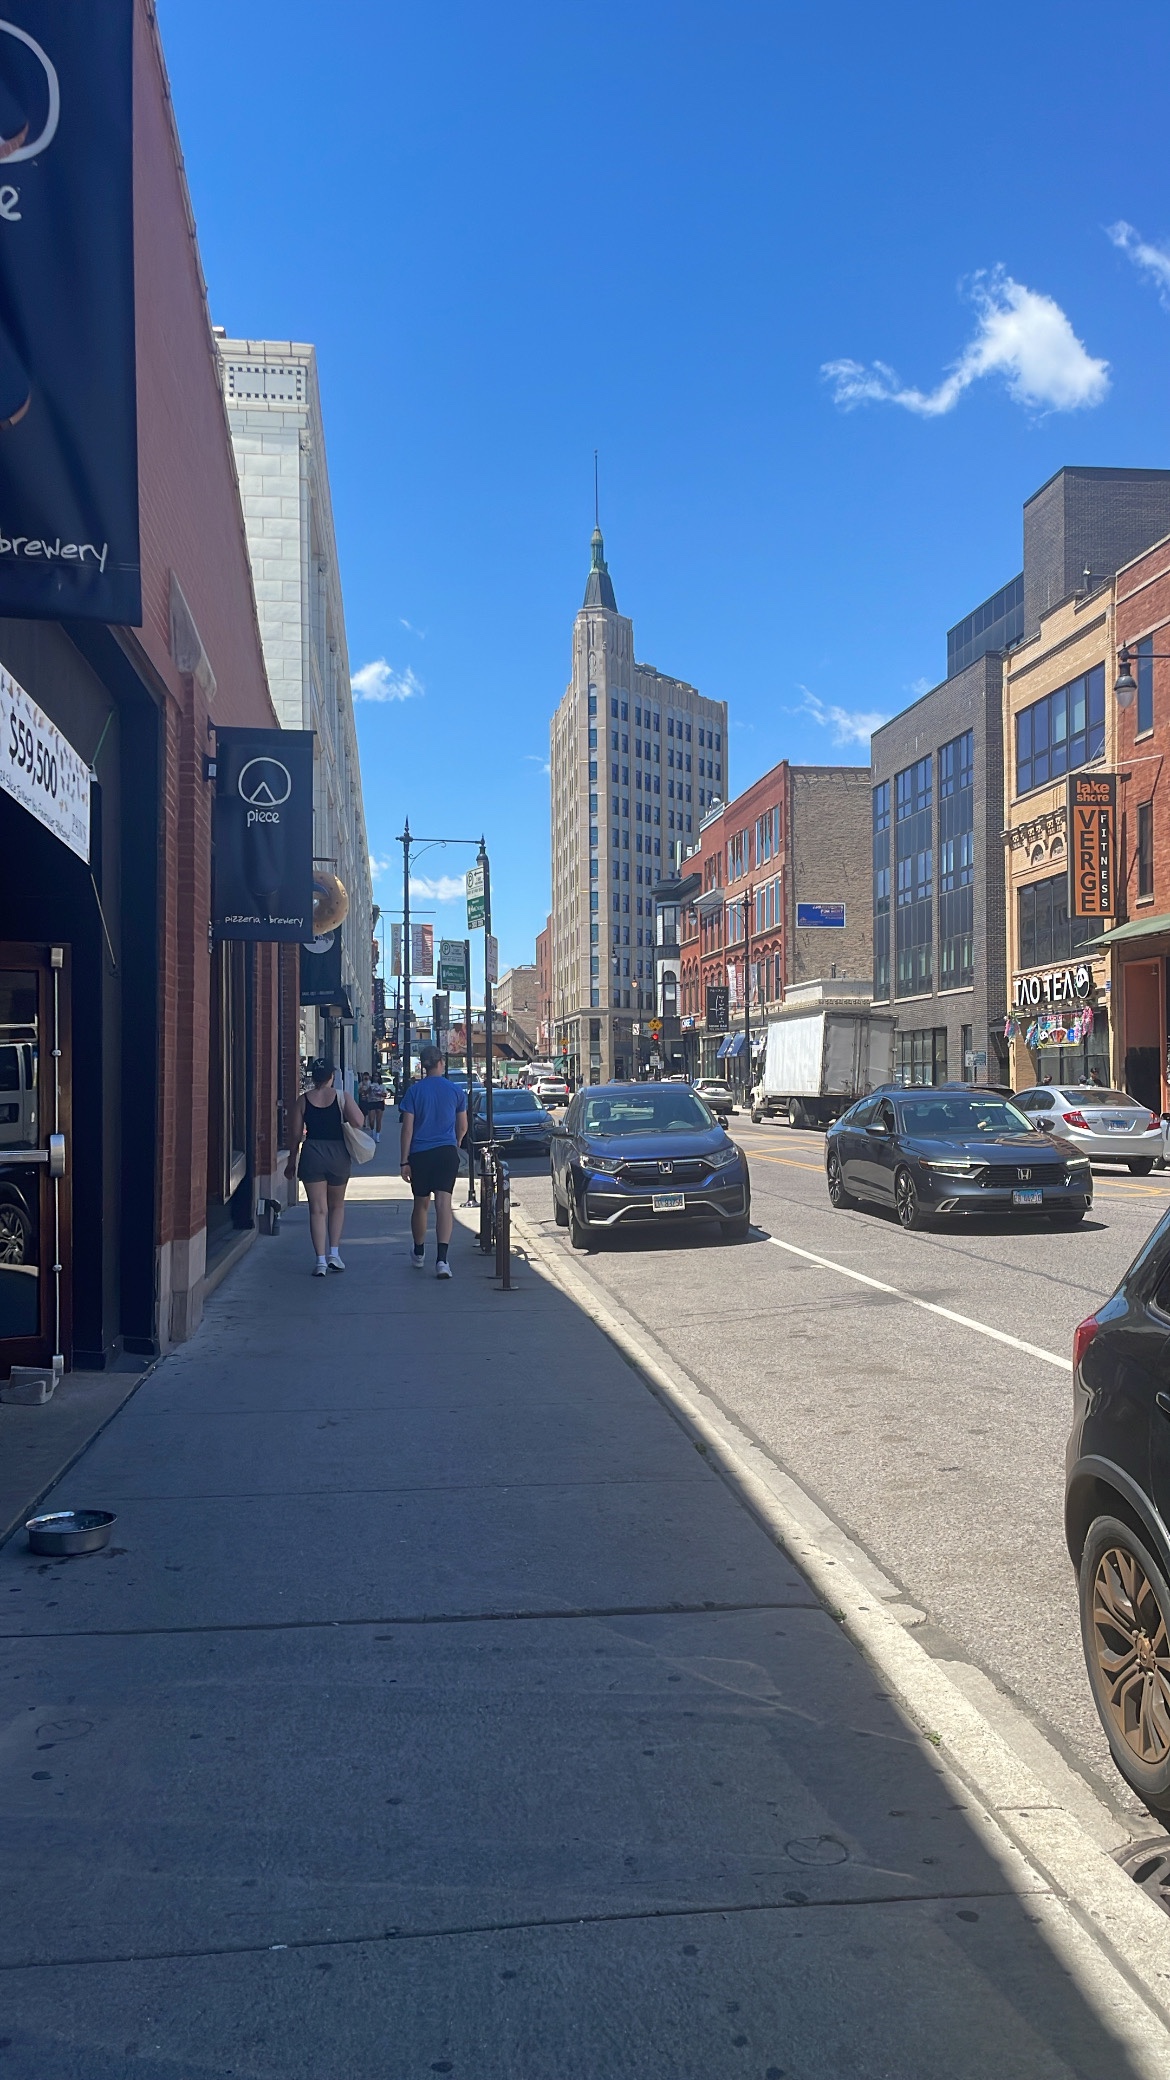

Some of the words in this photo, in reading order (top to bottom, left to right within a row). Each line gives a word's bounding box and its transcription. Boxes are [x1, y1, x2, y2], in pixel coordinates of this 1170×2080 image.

[0, 529, 108, 574] brewery
[9, 705, 58, 799] $59,500
[1076, 781, 1110, 794] lake
[1076, 793, 1110, 802] shore
[246, 809, 280, 828] piece
[1078, 810, 1097, 912] VERGE
[1100, 814, 1109, 907] FITNESS
[225, 915, 261, 924] pizzeria
[269, 915, 304, 928] brewery
[422, 935, 432, 973] Bucktown
[736, 972, 744, 1000] Bucktown
[1013, 976, 1040, 1007] TAO
[1043, 971, 1075, 1002] TEA
